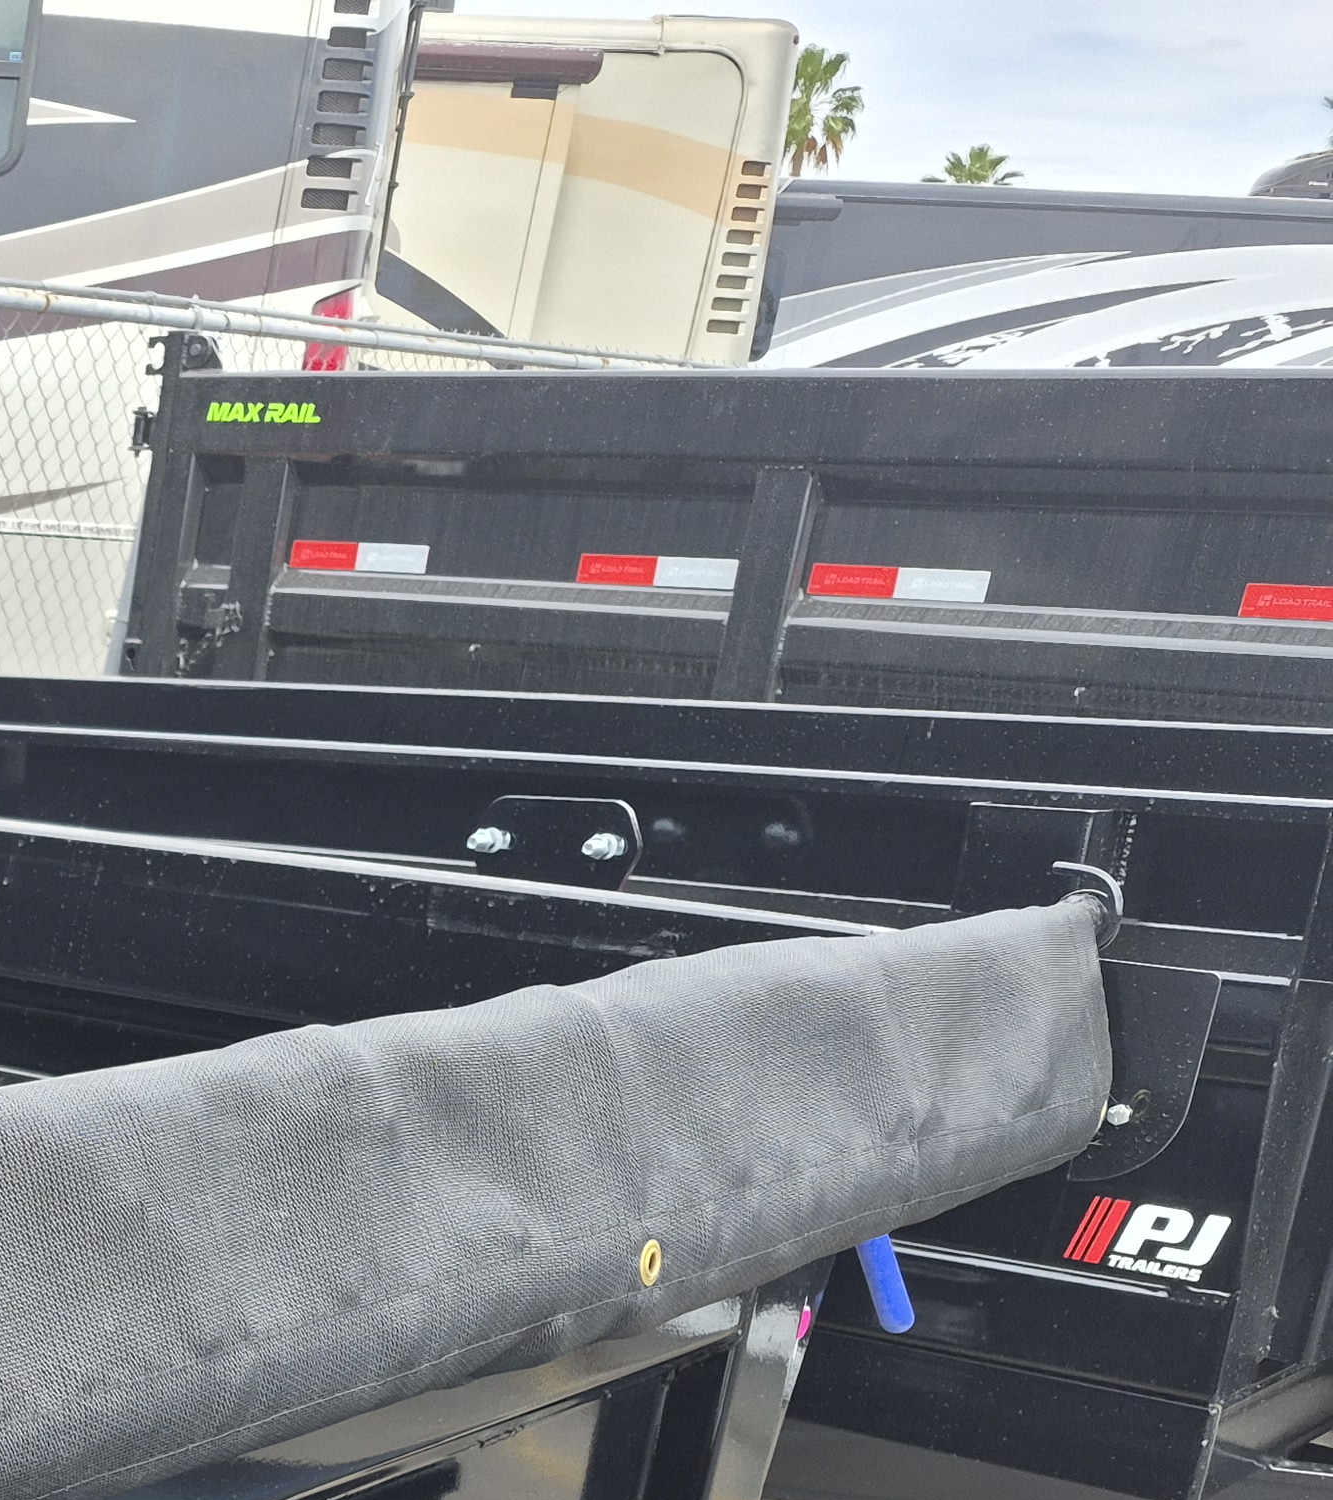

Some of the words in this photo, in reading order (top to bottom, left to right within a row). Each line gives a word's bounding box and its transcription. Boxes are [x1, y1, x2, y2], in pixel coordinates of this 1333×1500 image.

[206, 401, 265, 422] MAX
[264, 402, 321, 423] RAIL
[1113, 1203, 1232, 1267] PJ
[1107, 1254, 1203, 1283] TRAILERS
